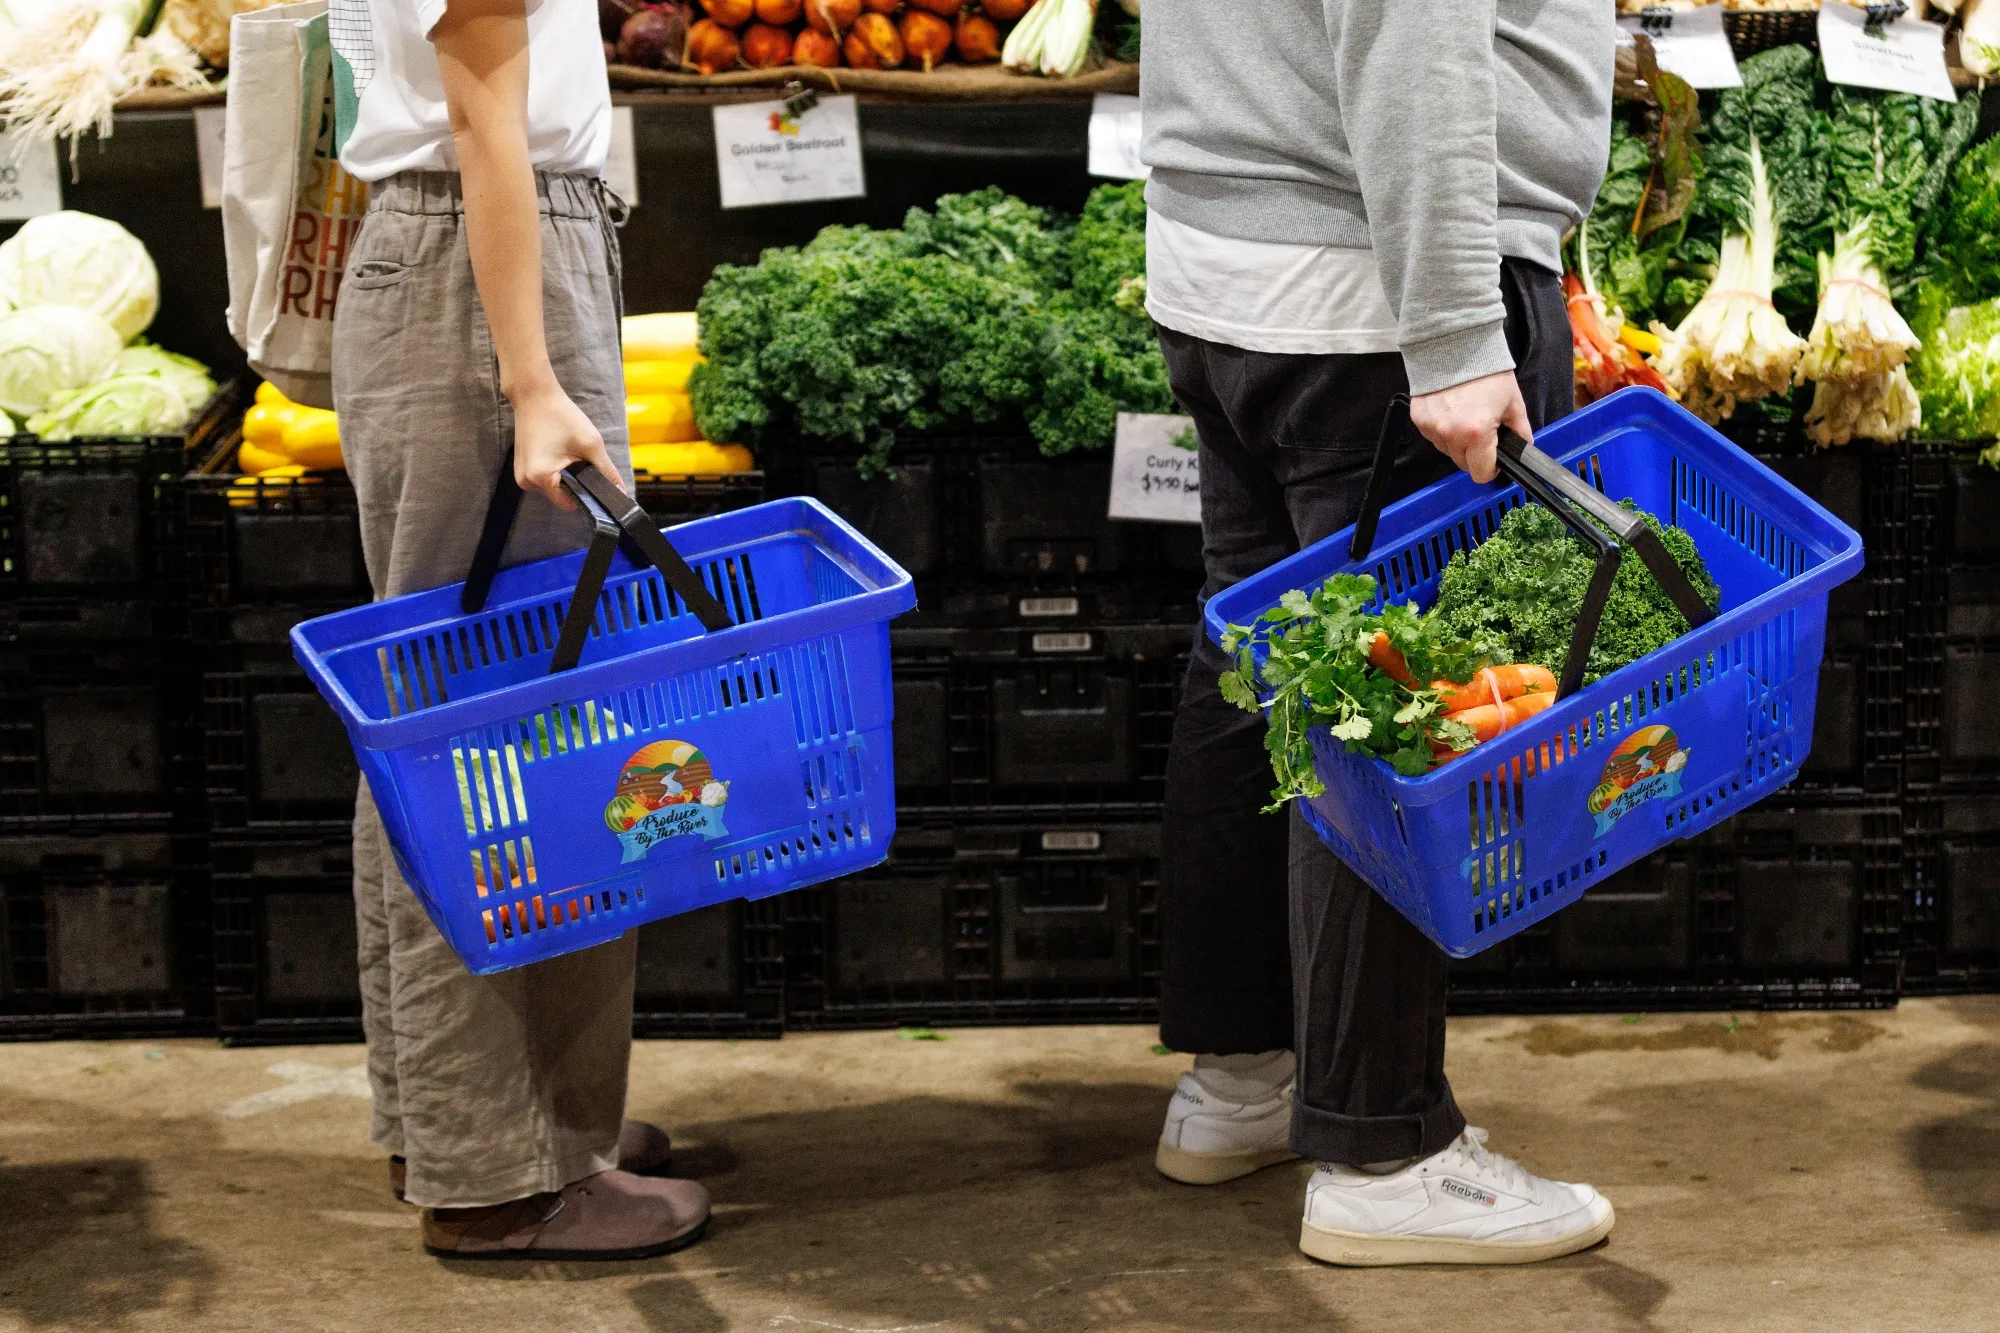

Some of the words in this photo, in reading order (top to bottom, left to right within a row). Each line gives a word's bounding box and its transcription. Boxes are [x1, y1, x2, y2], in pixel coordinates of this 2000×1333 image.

[1146, 455, 1182, 471] Curly
[1608, 808, 1623, 821] By
[1625, 799, 1641, 811] The
[1643, 783, 1668, 799] River
[1615, 777, 1662, 805] Produce
[642, 807, 698, 830] Produce
[635, 832, 653, 848] By
[655, 827, 675, 840] The
[678, 816, 708, 834] River
[1442, 1179, 1486, 1202] Reebok
